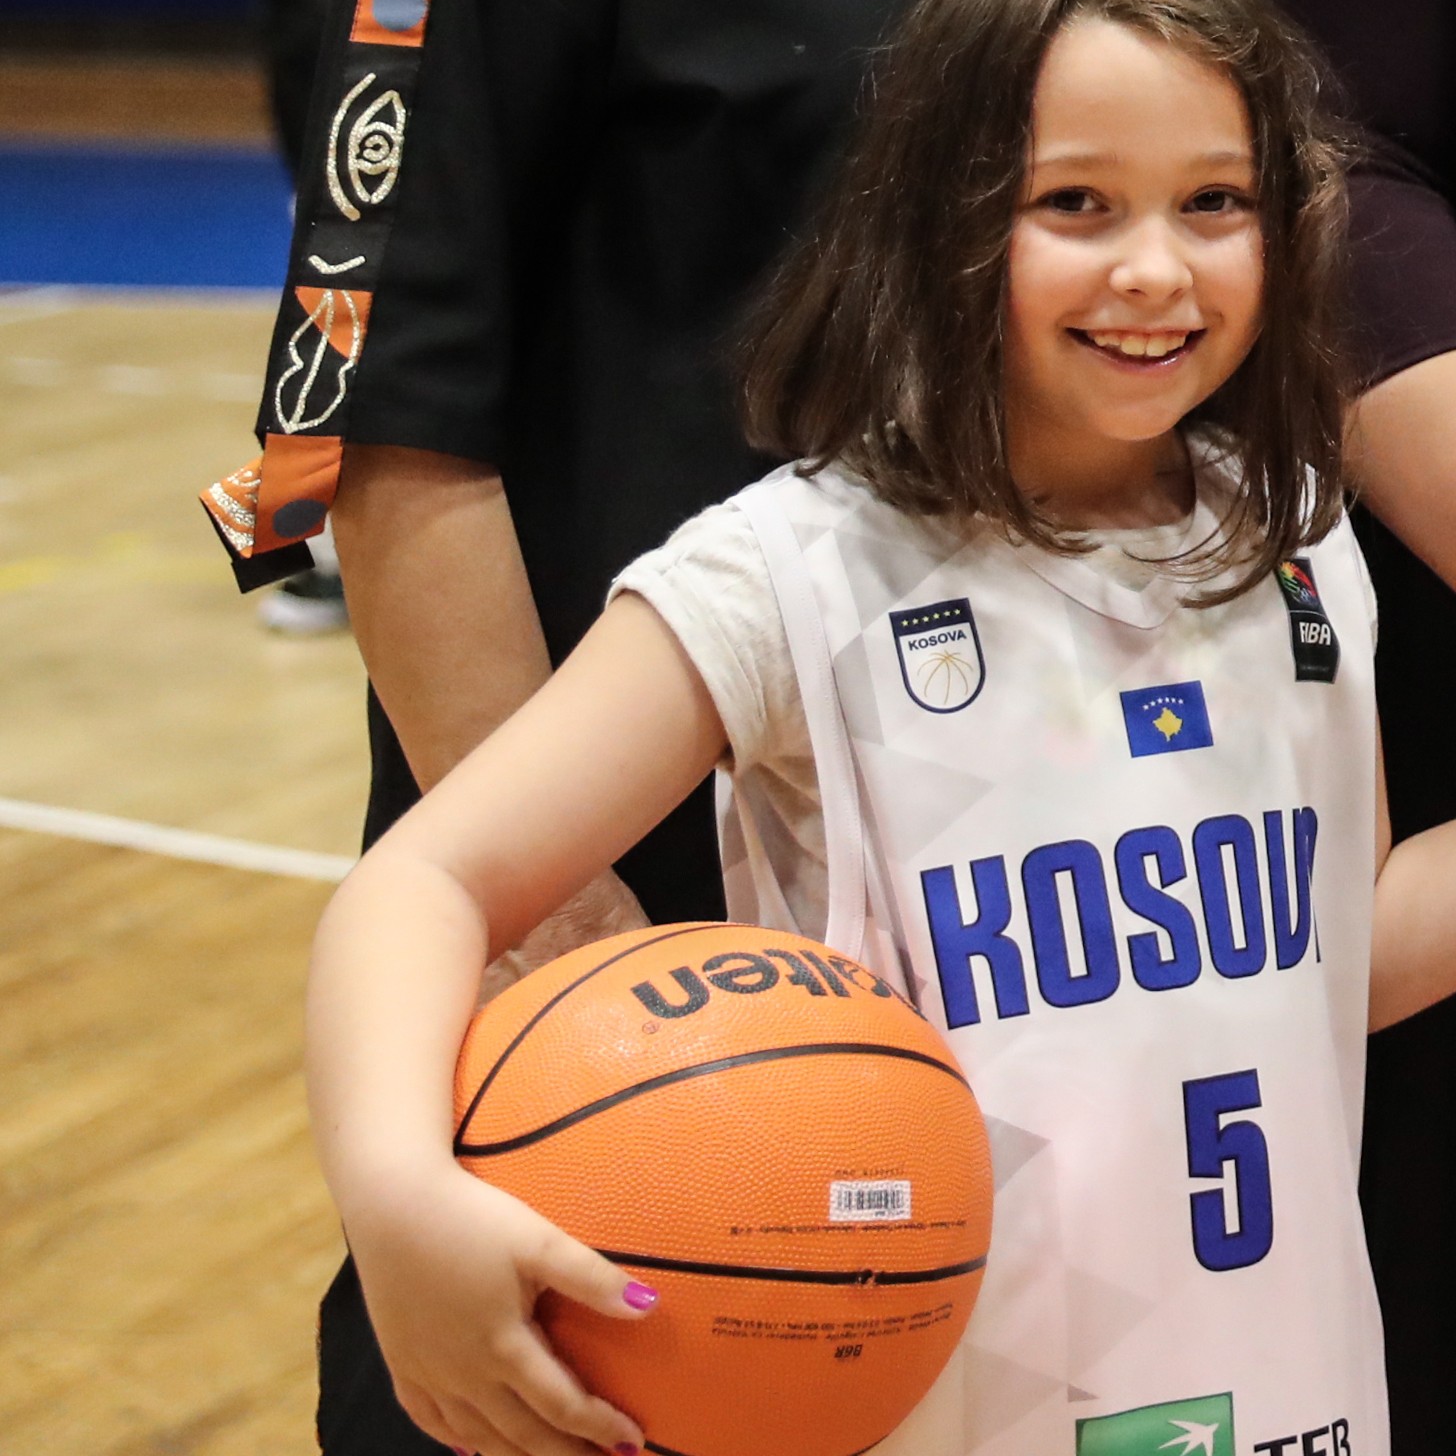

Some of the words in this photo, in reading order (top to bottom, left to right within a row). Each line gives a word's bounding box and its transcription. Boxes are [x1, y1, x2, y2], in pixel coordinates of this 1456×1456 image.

[908, 629, 967, 651] KOSOVA
[1299, 621, 1331, 646] FIBA
[1182, 1068, 1274, 1272] 5
